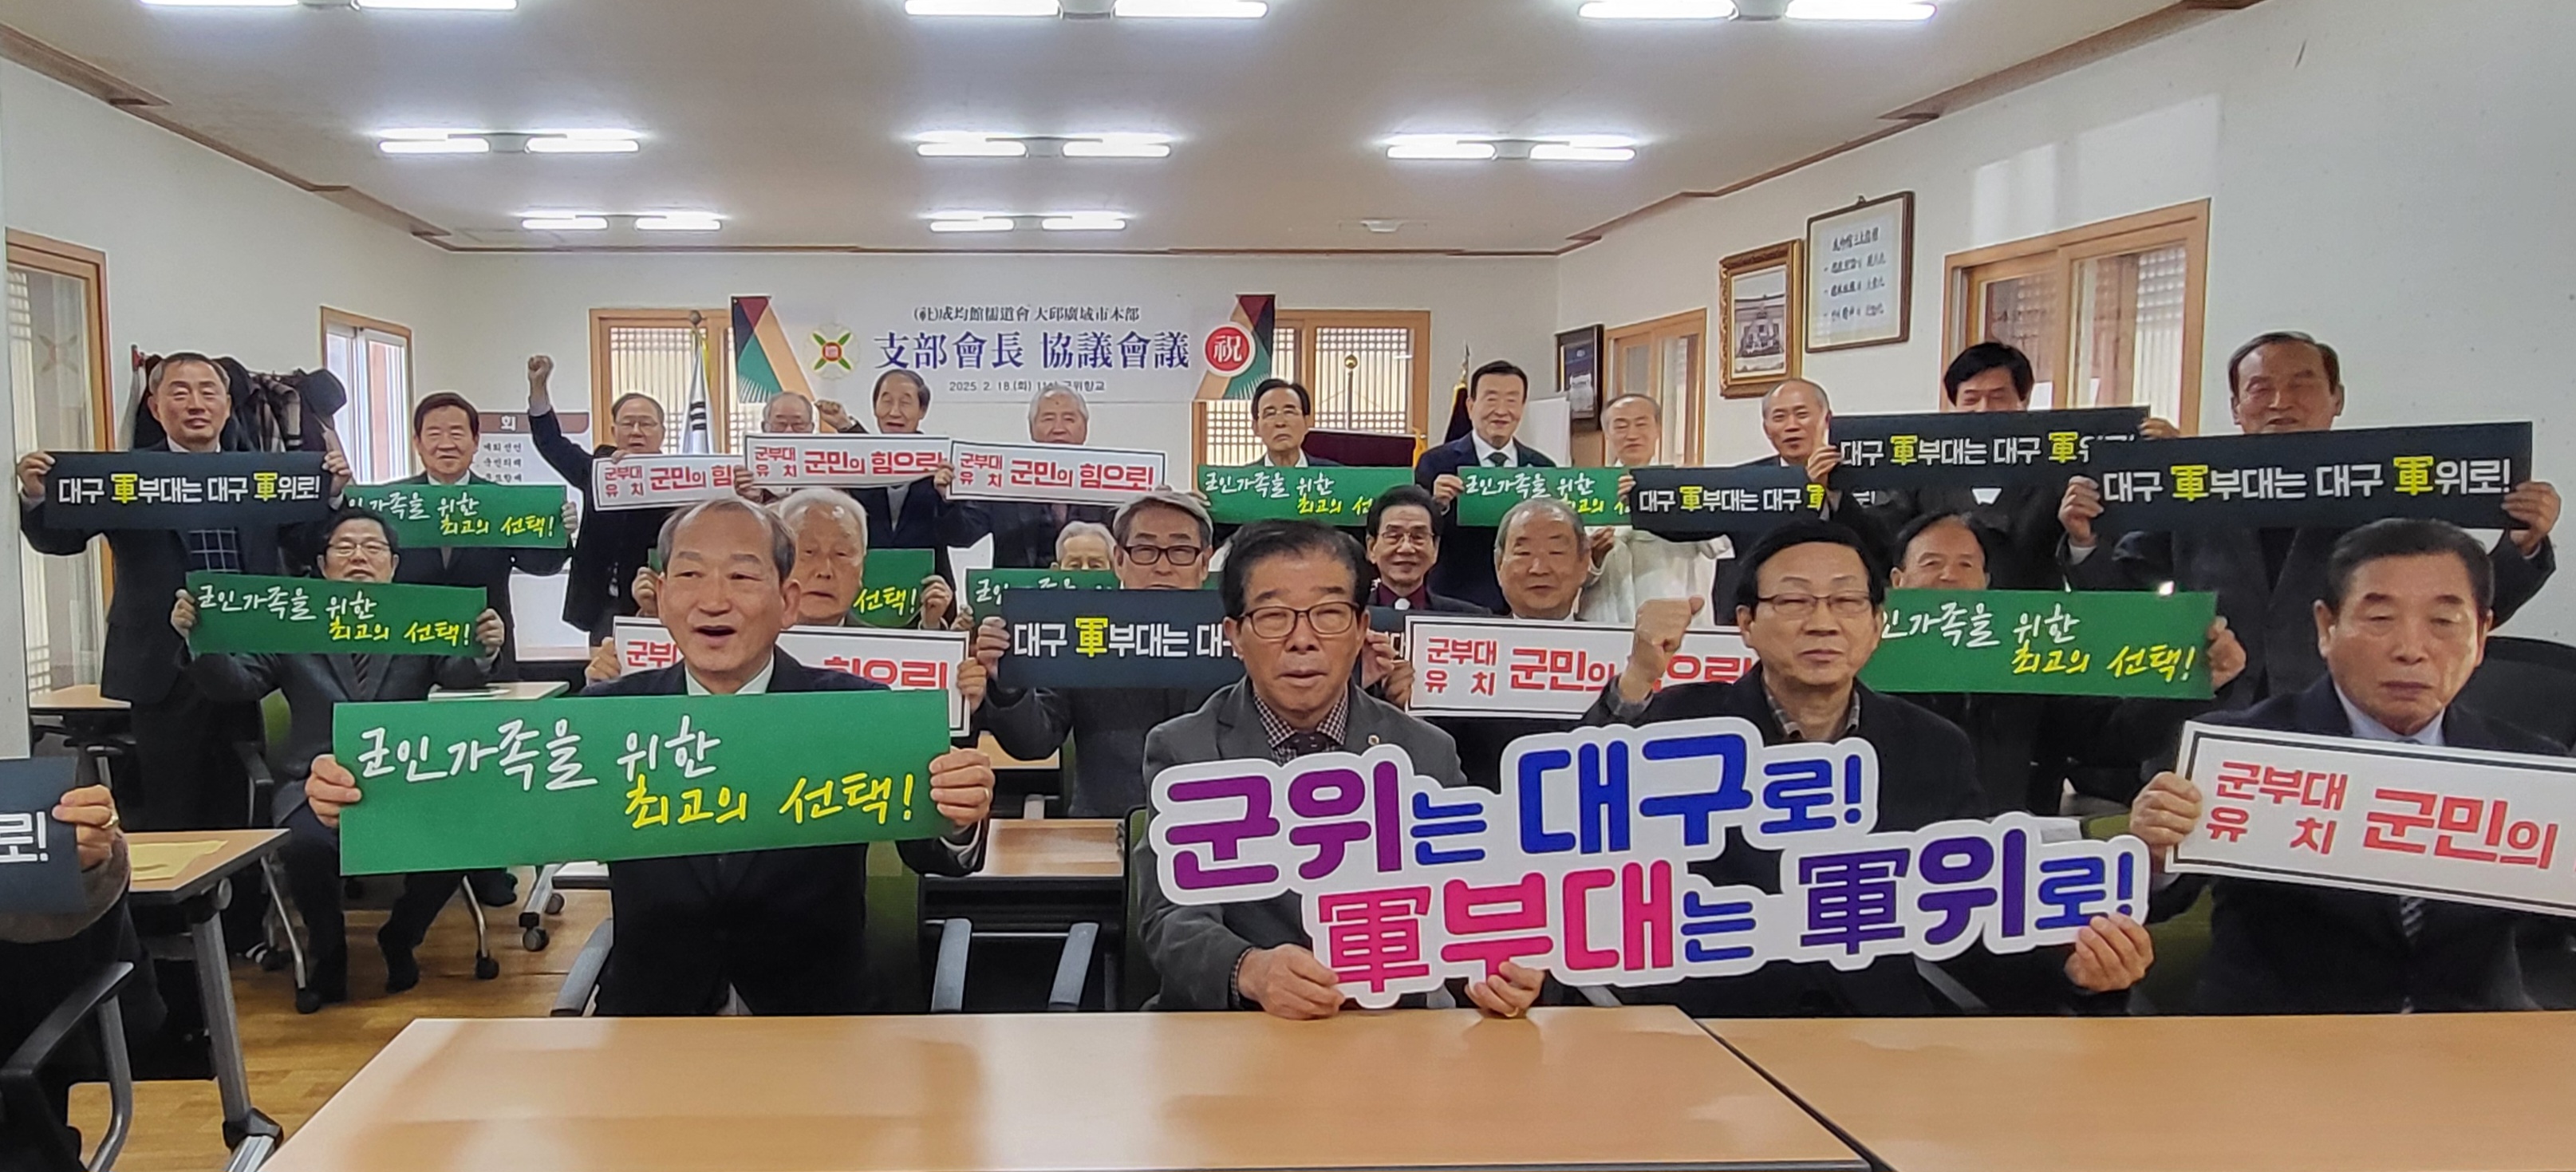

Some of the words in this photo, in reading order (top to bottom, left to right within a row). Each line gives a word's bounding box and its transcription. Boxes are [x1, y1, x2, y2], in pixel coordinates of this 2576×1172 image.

[874, 330, 1024, 369] 支部會長
[1039, 330, 1189, 369] 協議會議
[1213, 334, 1242, 363] 祝
[500, 415, 517, 432] 회
[754, 445, 797, 461] 군부대
[804, 450, 866, 475] 군민의
[1840, 440, 1884, 468] 대구
[1890, 435, 1987, 466] 軍부대는
[1994, 436, 2041, 465] 대구
[604, 465, 643, 480] 군부대
[650, 466, 707, 491] 군민의
[960, 452, 1004, 470] 군부대
[1010, 460, 1074, 487] 군민의
[1079, 463, 1154, 491] 힘으로!
[1205, 472, 1290, 499] 군인가족을
[1296, 472, 1335, 496] 위한
[1466, 472, 1552, 500] 군인가족을
[1557, 472, 1596, 496] 위한
[2103, 472, 2163, 503] 대구
[2170, 464, 2307, 502] 軍부대는
[2317, 464, 2384, 498] 대구
[2393, 456, 2511, 495] 軍위로!
[58, 478, 105, 503] 대구
[111, 473, 203, 504] 軍부대는
[207, 477, 249, 502] 대구
[254, 472, 320, 501] 軍위로!
[1639, 490, 1676, 512] 대구
[1679, 486, 1759, 512] 軍부대는
[1763, 488, 1802, 511] 대구
[349, 491, 430, 519] 인가족을
[437, 492, 479, 518] 위한
[1298, 495, 1343, 515] 최고의
[440, 515, 489, 535] 최고의
[500, 516, 554, 539] 선택!
[198, 585, 317, 621] 군인가족을
[325, 591, 377, 620] 위한
[853, 587, 917, 617] 선택!
[329, 616, 390, 641] 최고의
[404, 621, 470, 647] 선택!
[1013, 622, 1067, 657] 대구
[1075, 617, 1189, 657] 軍부대는
[1882, 601, 2001, 648] 인가족을
[2012, 603, 2081, 645] 위한
[626, 641, 678, 668] 군부
[1426, 637, 1497, 665] 군부대
[1509, 646, 1615, 693] 군민의
[2011, 639, 2092, 676] 최고의
[2106, 645, 2195, 683] 선택!
[357, 717, 598, 791] 군인가족을
[617, 715, 721, 783] 위한
[625, 772, 747, 829] 최고의
[780, 772, 914, 825] 선택!
[1165, 760, 1487, 890] 군위는
[1517, 732, 1862, 858] 대구로!
[2216, 760, 2349, 811] 군부대
[2362, 787, 2558, 870] 군민의
[1317, 858, 1757, 995] 軍부대는
[1797, 827, 2135, 957] 軍위로!
